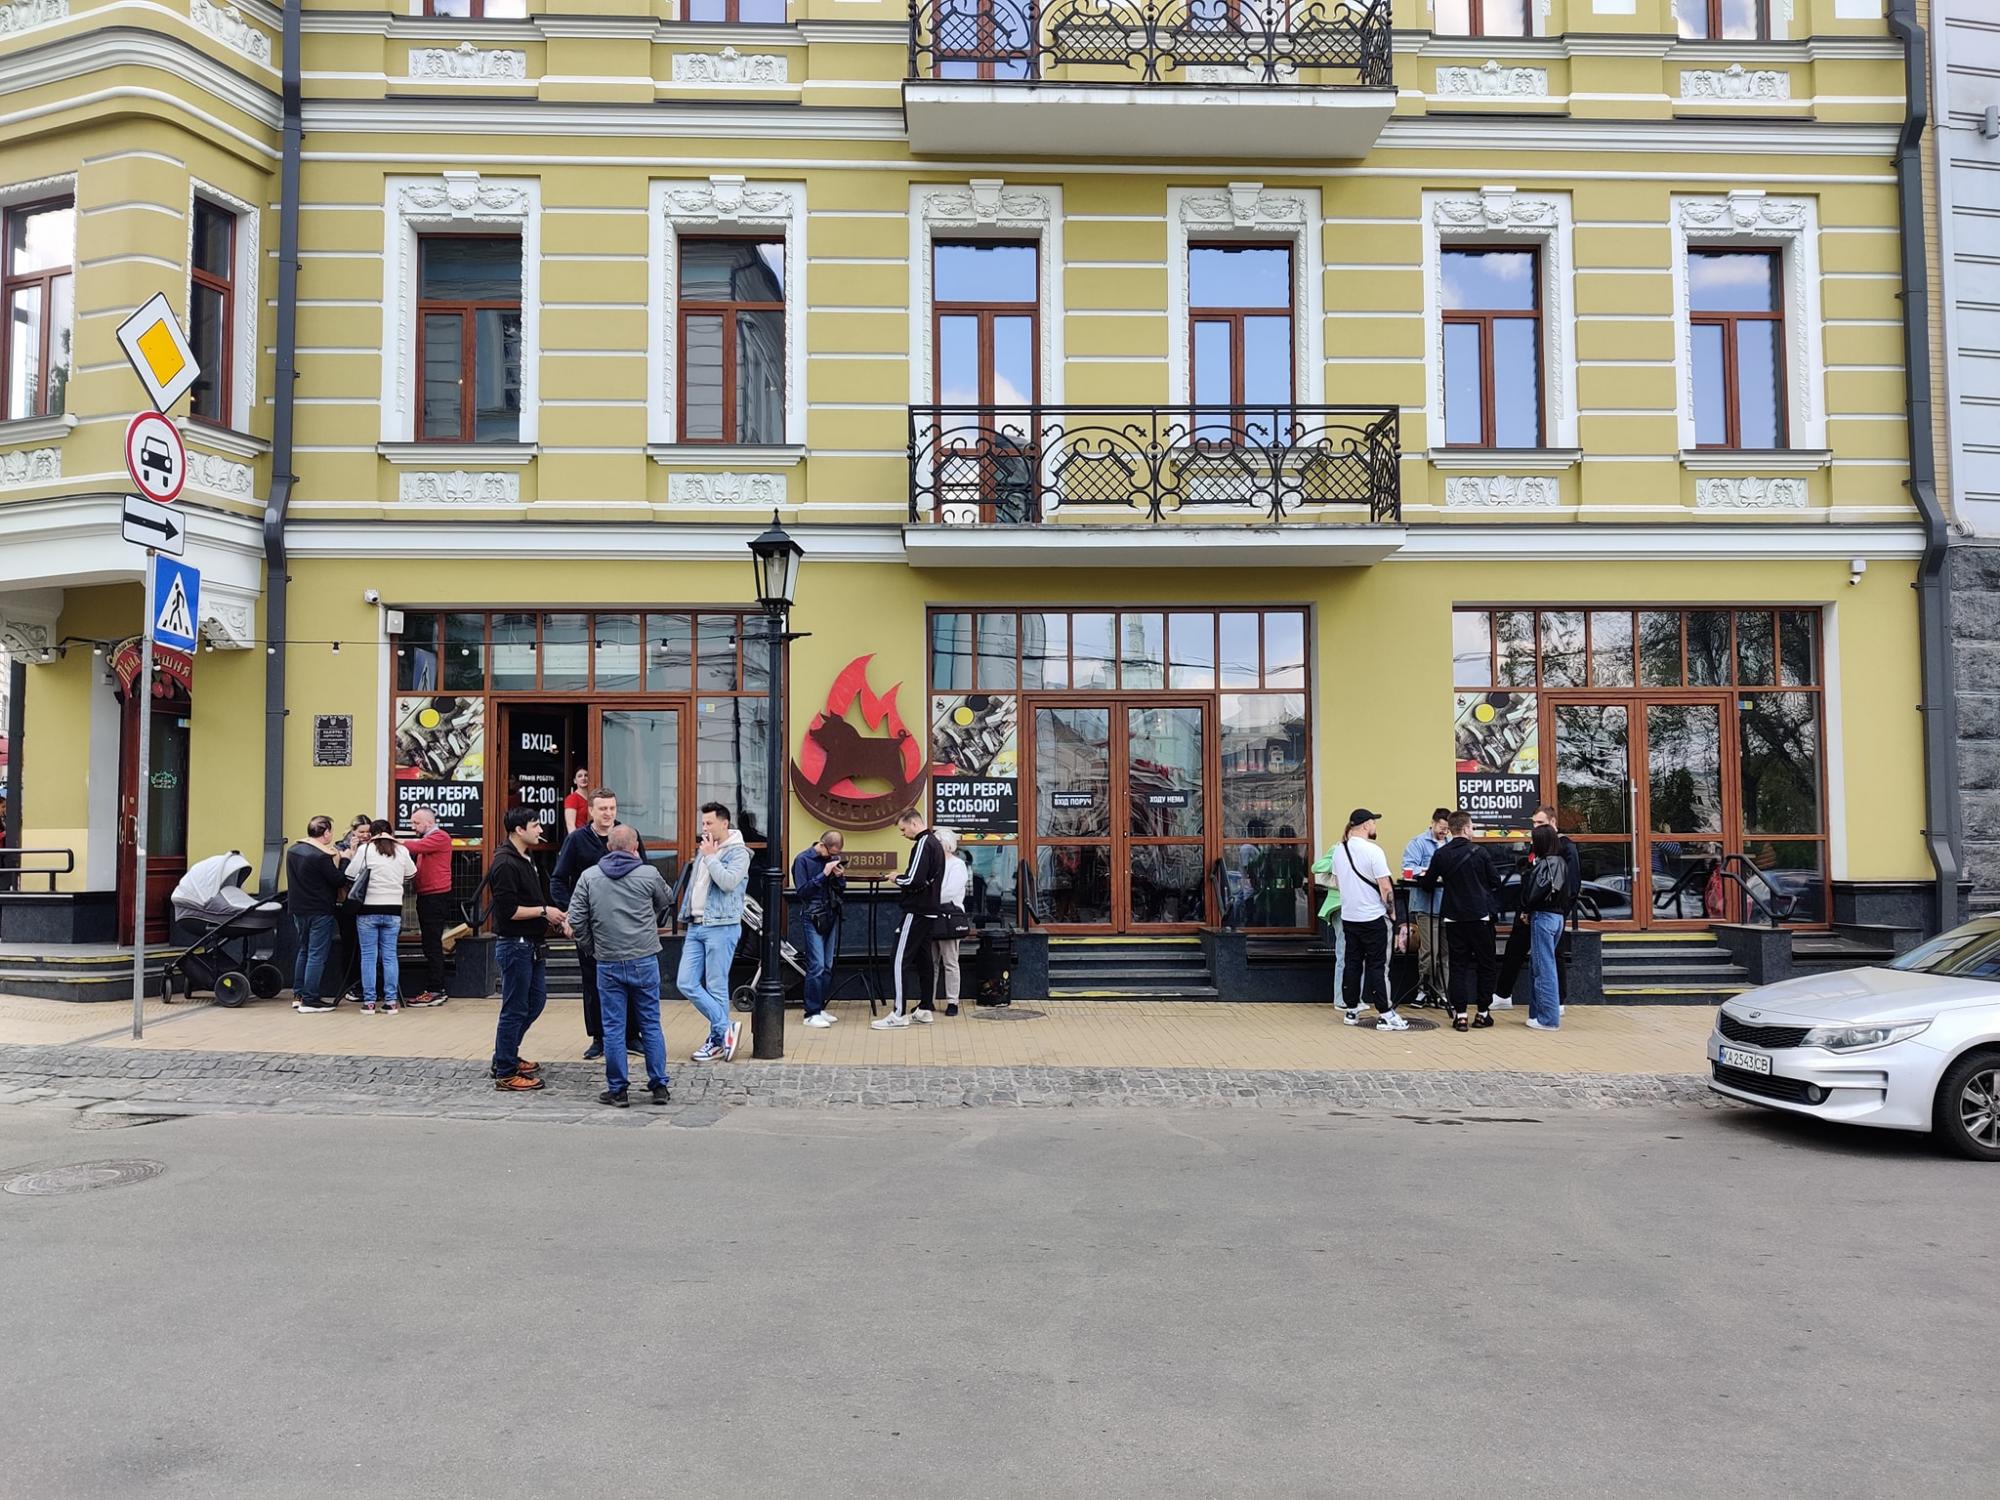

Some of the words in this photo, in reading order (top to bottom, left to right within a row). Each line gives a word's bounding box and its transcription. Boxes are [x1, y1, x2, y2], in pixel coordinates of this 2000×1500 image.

[522, 733, 553, 752] ВХІД
[936, 782, 970, 796] БЕРИ
[973, 782, 1013, 796] РЕБРА
[1459, 779, 1492, 793] БЕРИ
[1495, 779, 1535, 793] РЕБРА
[399, 786, 434, 801] БЕРИ
[437, 786, 479, 801] РЕБРА
[519, 786, 556, 803] 12:00
[935, 799, 945, 812] З
[948, 799, 1000, 812] СОБОЮ!
[1054, 798, 1069, 806] ВХІД
[1070, 798, 1092, 806] ПОРУЧ
[1459, 795, 1469, 809] З
[1471, 795, 1523, 809] СОБОЮ!
[399, 803, 408, 817] З
